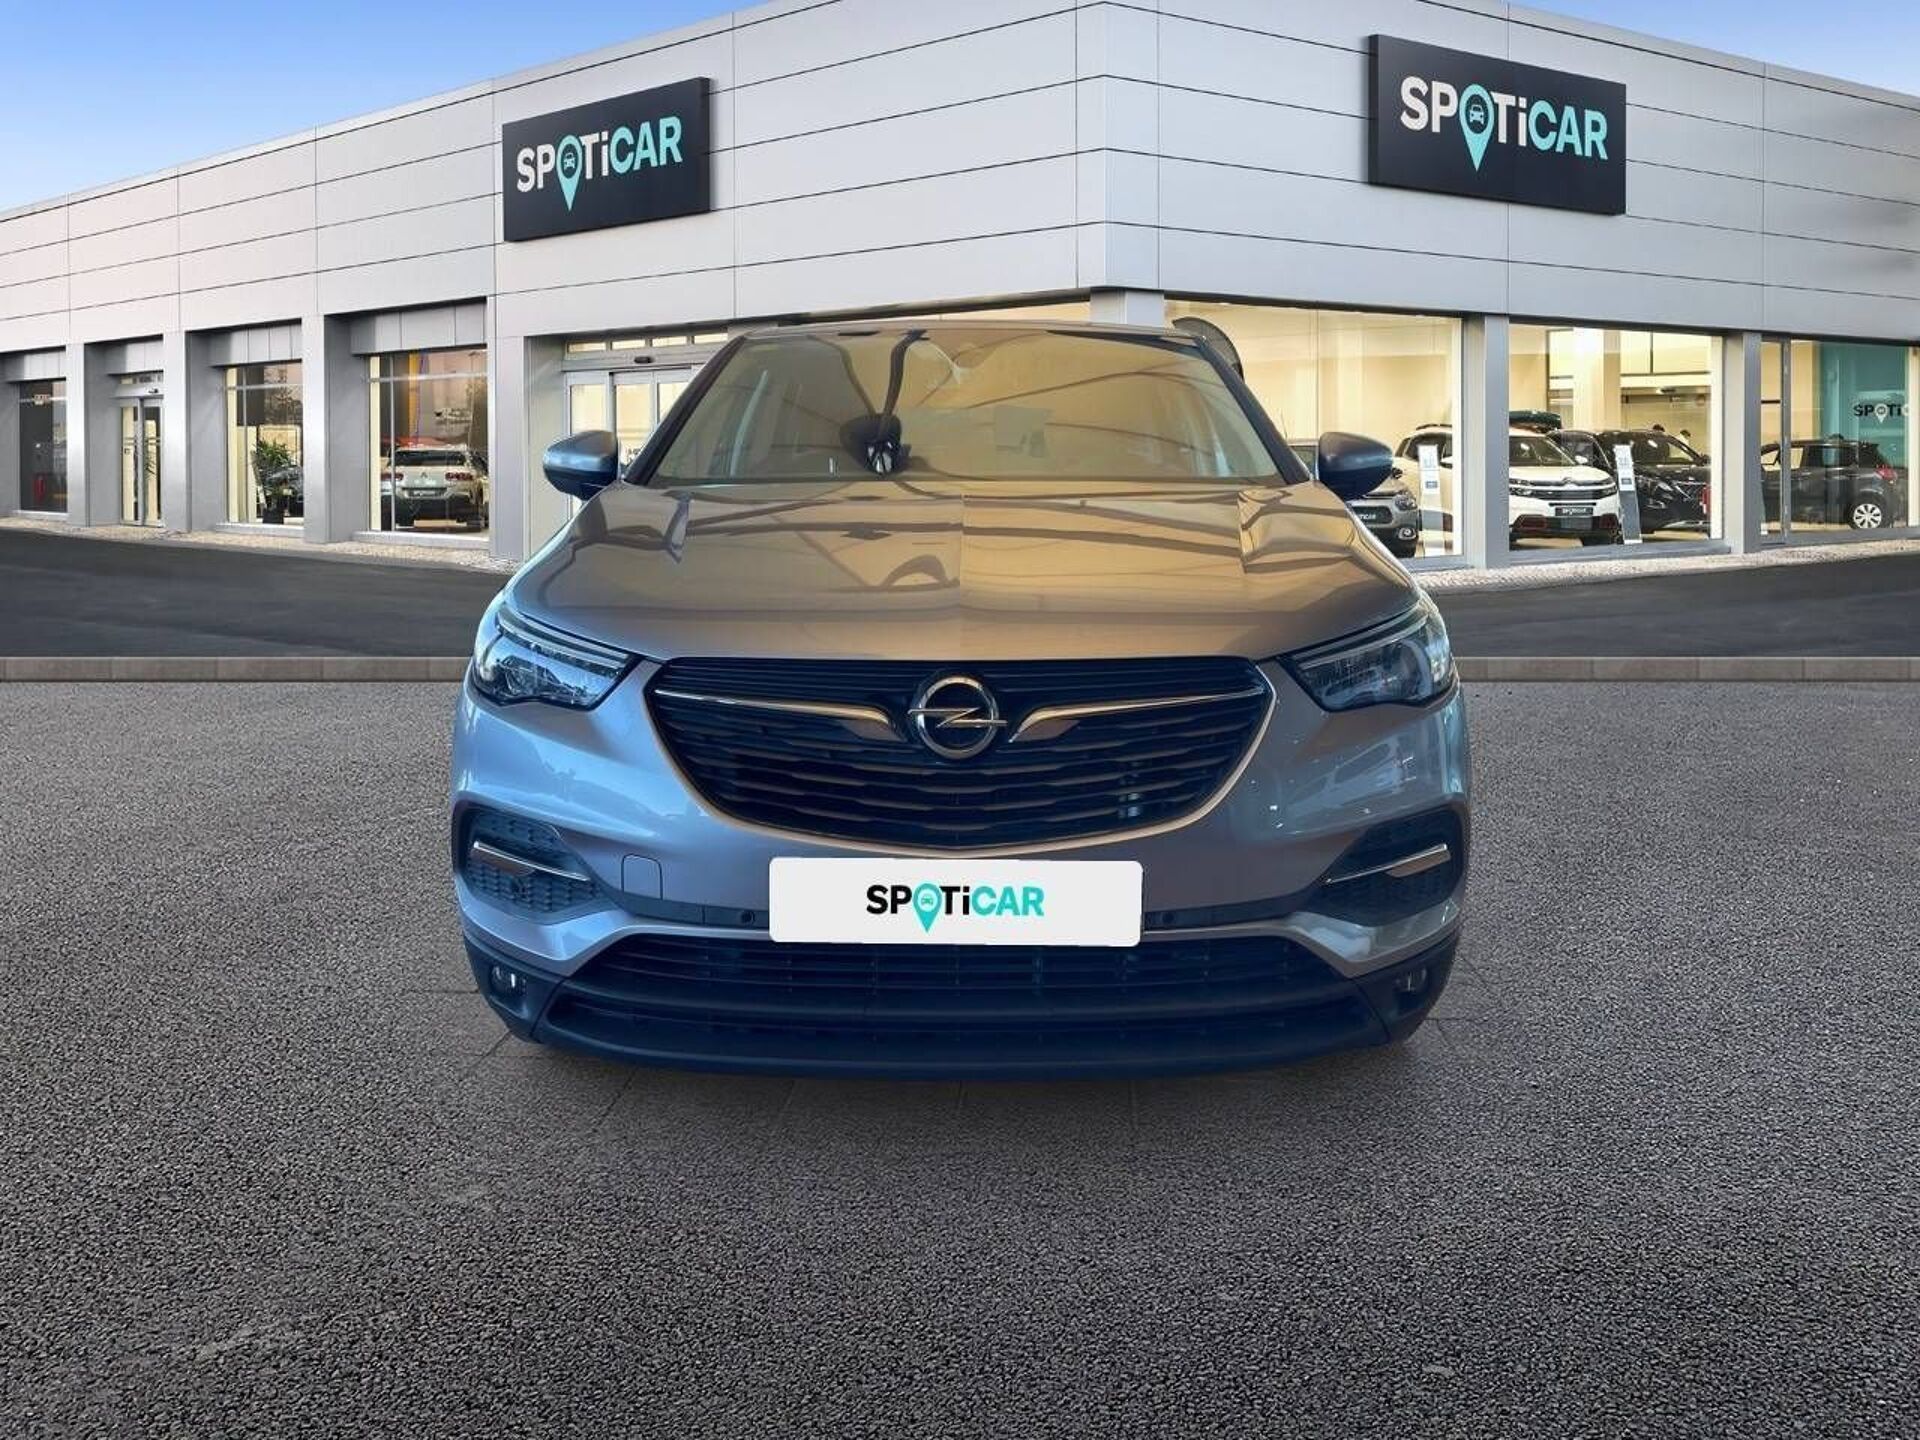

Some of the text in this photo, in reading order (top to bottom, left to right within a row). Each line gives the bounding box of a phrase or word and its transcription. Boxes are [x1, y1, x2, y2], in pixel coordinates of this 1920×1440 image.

[516, 115, 683, 212] SPOTiCAR
[1399, 75, 1609, 172] SPOTiCAR
[865, 882, 1045, 934] SPOTiCAR
